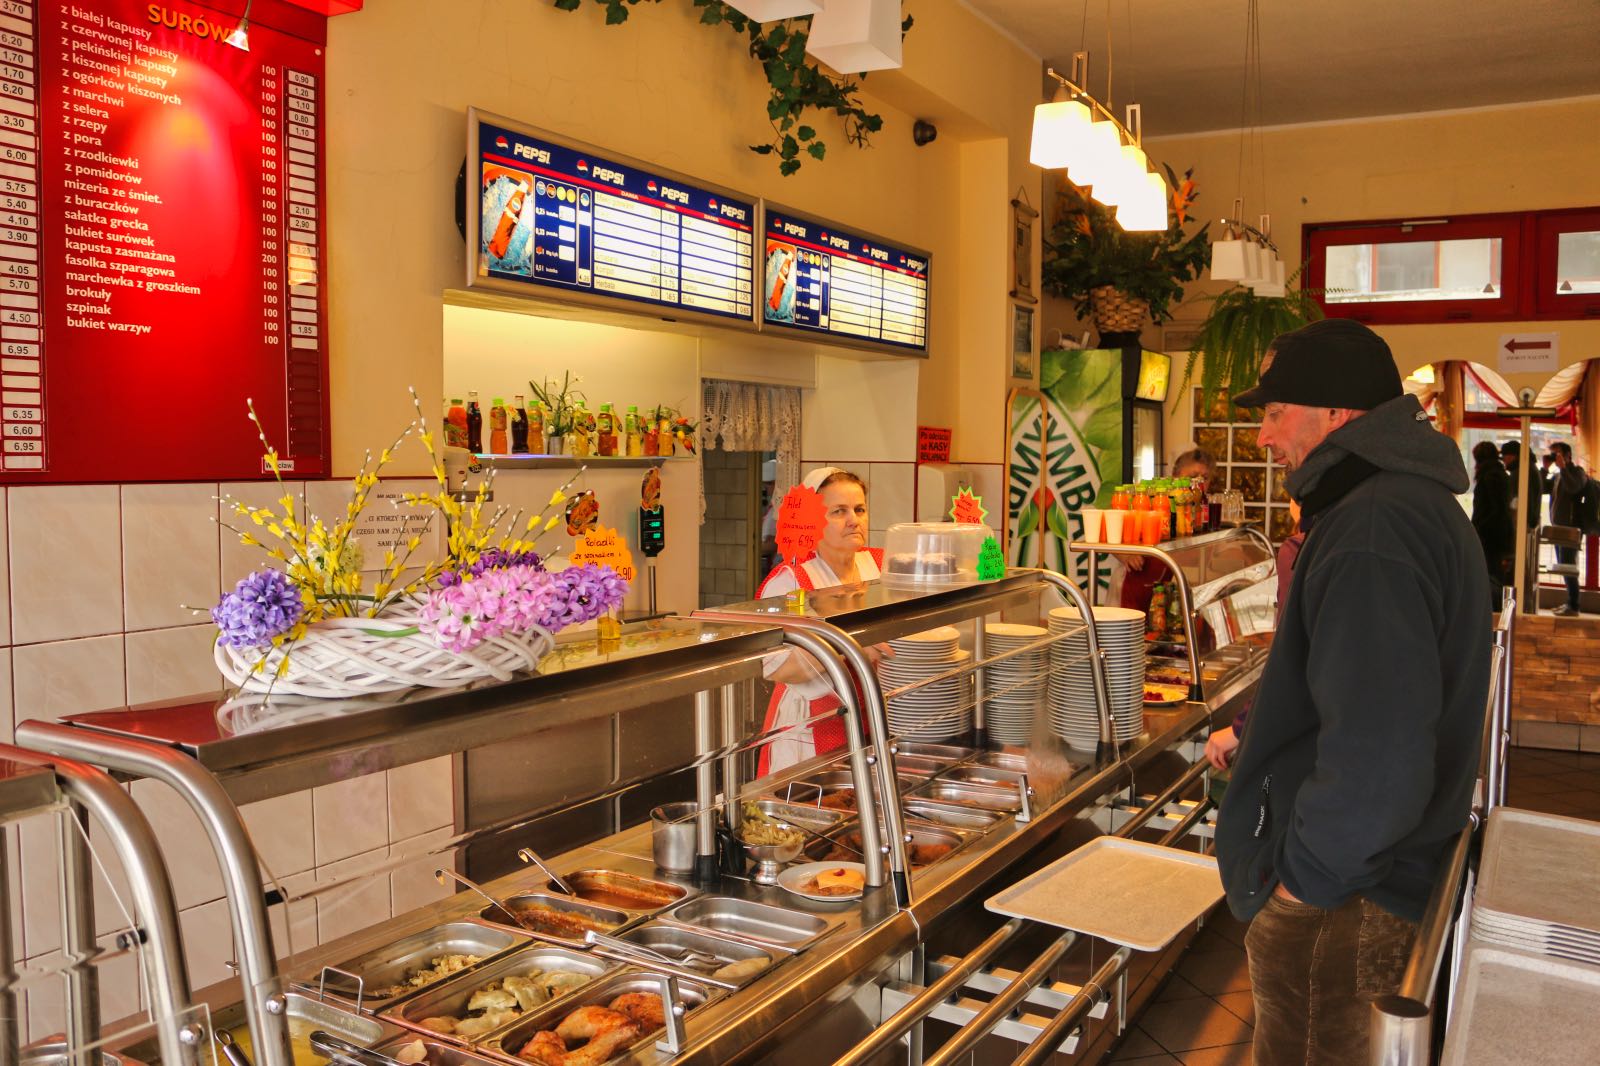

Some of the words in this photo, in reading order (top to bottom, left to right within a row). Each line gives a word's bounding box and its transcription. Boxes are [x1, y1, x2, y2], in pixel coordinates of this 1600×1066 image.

[61, 6, 68, 14] z
[72, 6, 103, 28] białej
[107, 17, 152, 40] kapusty
[148, 4, 235, 43] SURÓW
[61, 21, 68, 30] z
[72, 25, 132, 50] czerwonej
[136, 40, 178, 64] kapusty
[61, 37, 69, 46] z
[72, 40, 131, 65] pekińskiej
[135, 55, 178, 77] kapusty
[62, 53, 69, 62] z
[73, 53, 120, 78] kiszonej
[124, 67, 168, 89] kapusty
[262, 65, 276, 76] 100
[62, 69, 69, 77] z
[73, 71, 125, 91] ogórków
[128, 83, 181, 105] kiszonych
[262, 78, 276, 89] 100
[62, 86, 69, 94] z
[73, 88, 124, 108] marchwi
[262, 92, 276, 102] 100
[62, 101, 70, 110] z
[74, 104, 109, 119] selera
[262, 105, 276, 116] 100
[63, 116, 70, 124] z
[74, 117, 107, 134] rzepy
[262, 119, 276, 129] 100
[64, 131, 70, 140] z
[74, 134, 102, 146] pora
[262, 132, 276, 143] 100
[64, 147, 71, 155] z
[75, 149, 138, 169] rzodkiewki
[262, 146, 276, 156] 100
[514, 143, 551, 164] PEPSI
[262, 159, 276, 170] 100
[65, 163, 72, 172] z
[76, 165, 142, 185] pomidorów
[262, 173, 276, 183] 100
[593, 166, 624, 185] PEPSI
[65, 179, 109, 195] mizeria
[112, 188, 126, 197] ze
[129, 189, 163, 204] śmiet.
[262, 186, 276, 196] 100
[661, 186, 689, 204] PEPSI
[65, 196, 72, 204] z
[75, 195, 139, 214] buraczków
[262, 200, 276, 210] 100
[721, 204, 746, 220] PEPSI
[65, 210, 107, 225] sałatka
[110, 218, 149, 231] grecka
[263, 214, 277, 223] 100
[65, 224, 103, 240] bukiet
[107, 232, 154, 247] surówek
[263, 227, 277, 237] 100
[784, 223, 806, 238] PEPSI
[66, 238, 112, 255] kapusta
[115, 247, 176, 263] zasmażana
[263, 241, 277, 250] 100
[830, 236, 849, 250] PEPSI
[262, 254, 277, 264] 200
[871, 248, 888, 261] PEPSI
[65, 254, 107, 269] fasolka
[110, 262, 175, 278] szparagowa
[263, 268, 277, 277] 100
[66, 272, 134, 287] marchewka
[137, 280, 143, 288] z
[146, 281, 201, 295] groszkiem
[264, 282, 277, 291] 100
[66, 285, 112, 302] brokuły
[264, 295, 278, 304] 100
[67, 302, 111, 315] szpinak
[264, 308, 278, 317] 100
[67, 316, 105, 330] bukiet
[108, 322, 152, 335] warzyw
[264, 322, 278, 331] 100
[264, 336, 278, 345] 100
